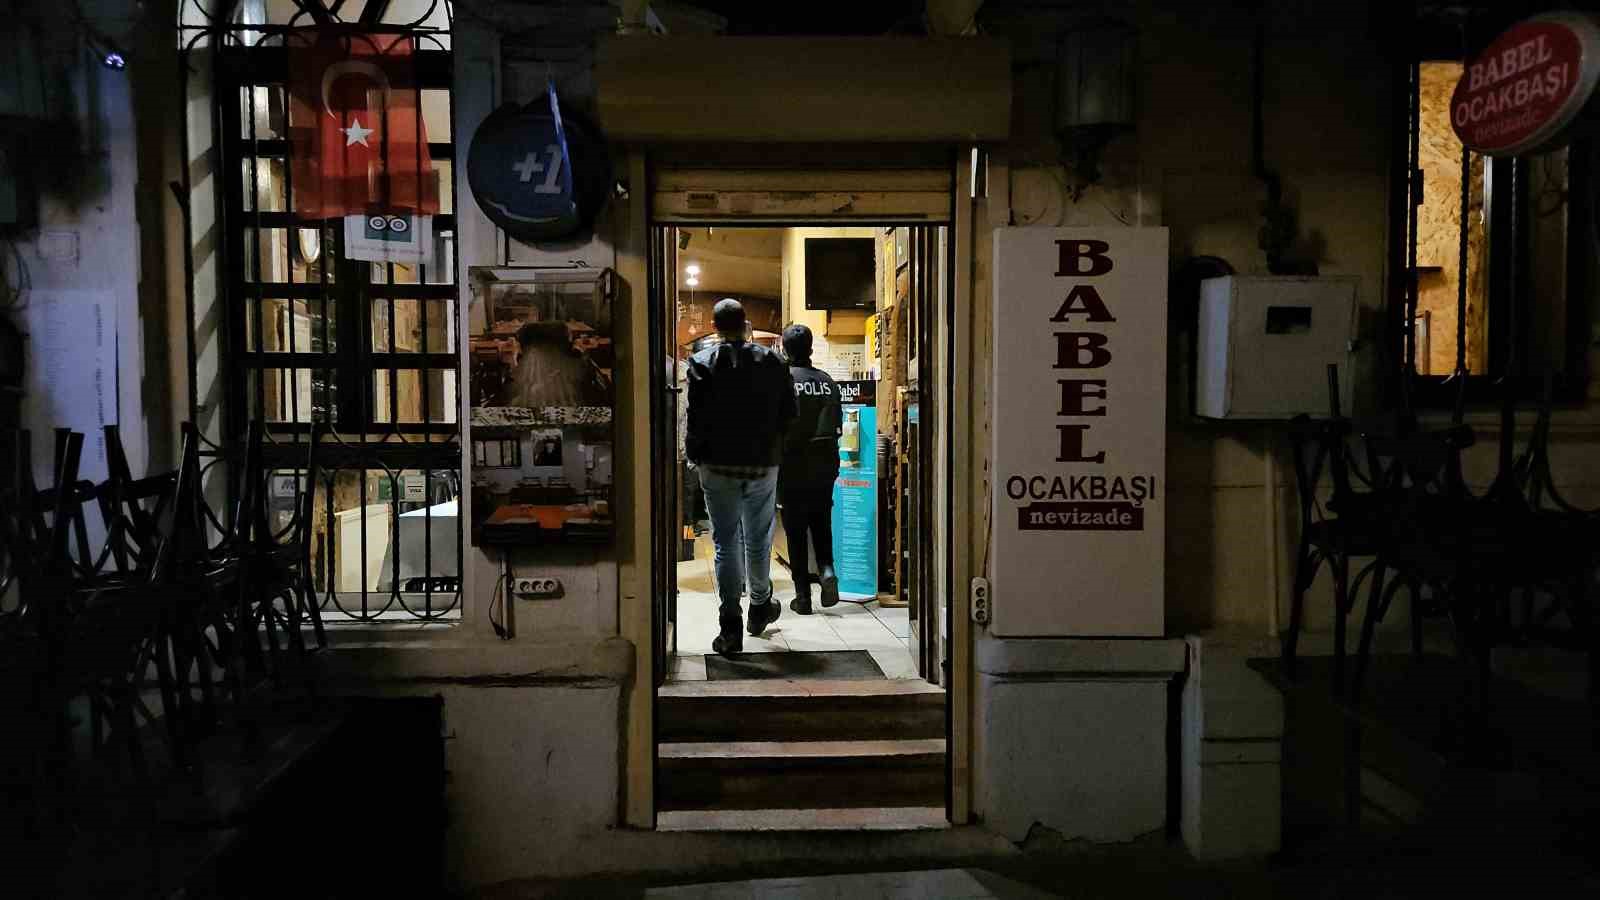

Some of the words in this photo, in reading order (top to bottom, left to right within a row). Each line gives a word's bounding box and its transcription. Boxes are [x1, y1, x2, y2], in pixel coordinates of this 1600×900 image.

[1469, 33, 1552, 92] BABEL
[1455, 62, 1569, 127] OCAKBAŞI
[511, 143, 562, 194] +1
[1050, 239, 1116, 464] BABEL
[1006, 476, 1155, 507] OCAKBAŞI
[1029, 507, 1134, 525] nevizade
